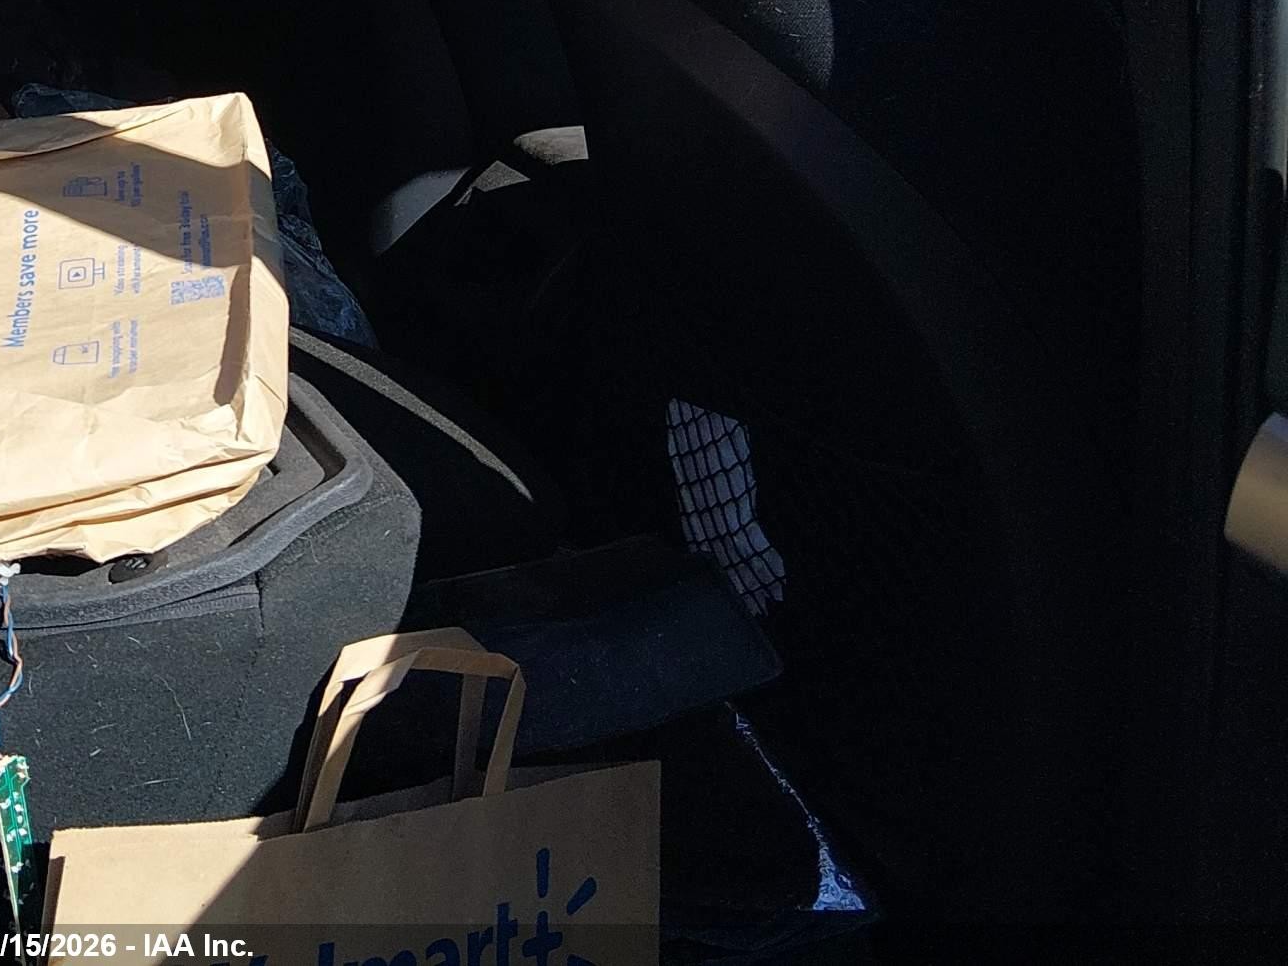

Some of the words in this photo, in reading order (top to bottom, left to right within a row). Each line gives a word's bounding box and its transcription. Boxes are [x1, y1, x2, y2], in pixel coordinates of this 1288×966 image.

[21, 210, 39, 251] more
[18, 255, 36, 289] save
[0, 290, 33, 348] Members
